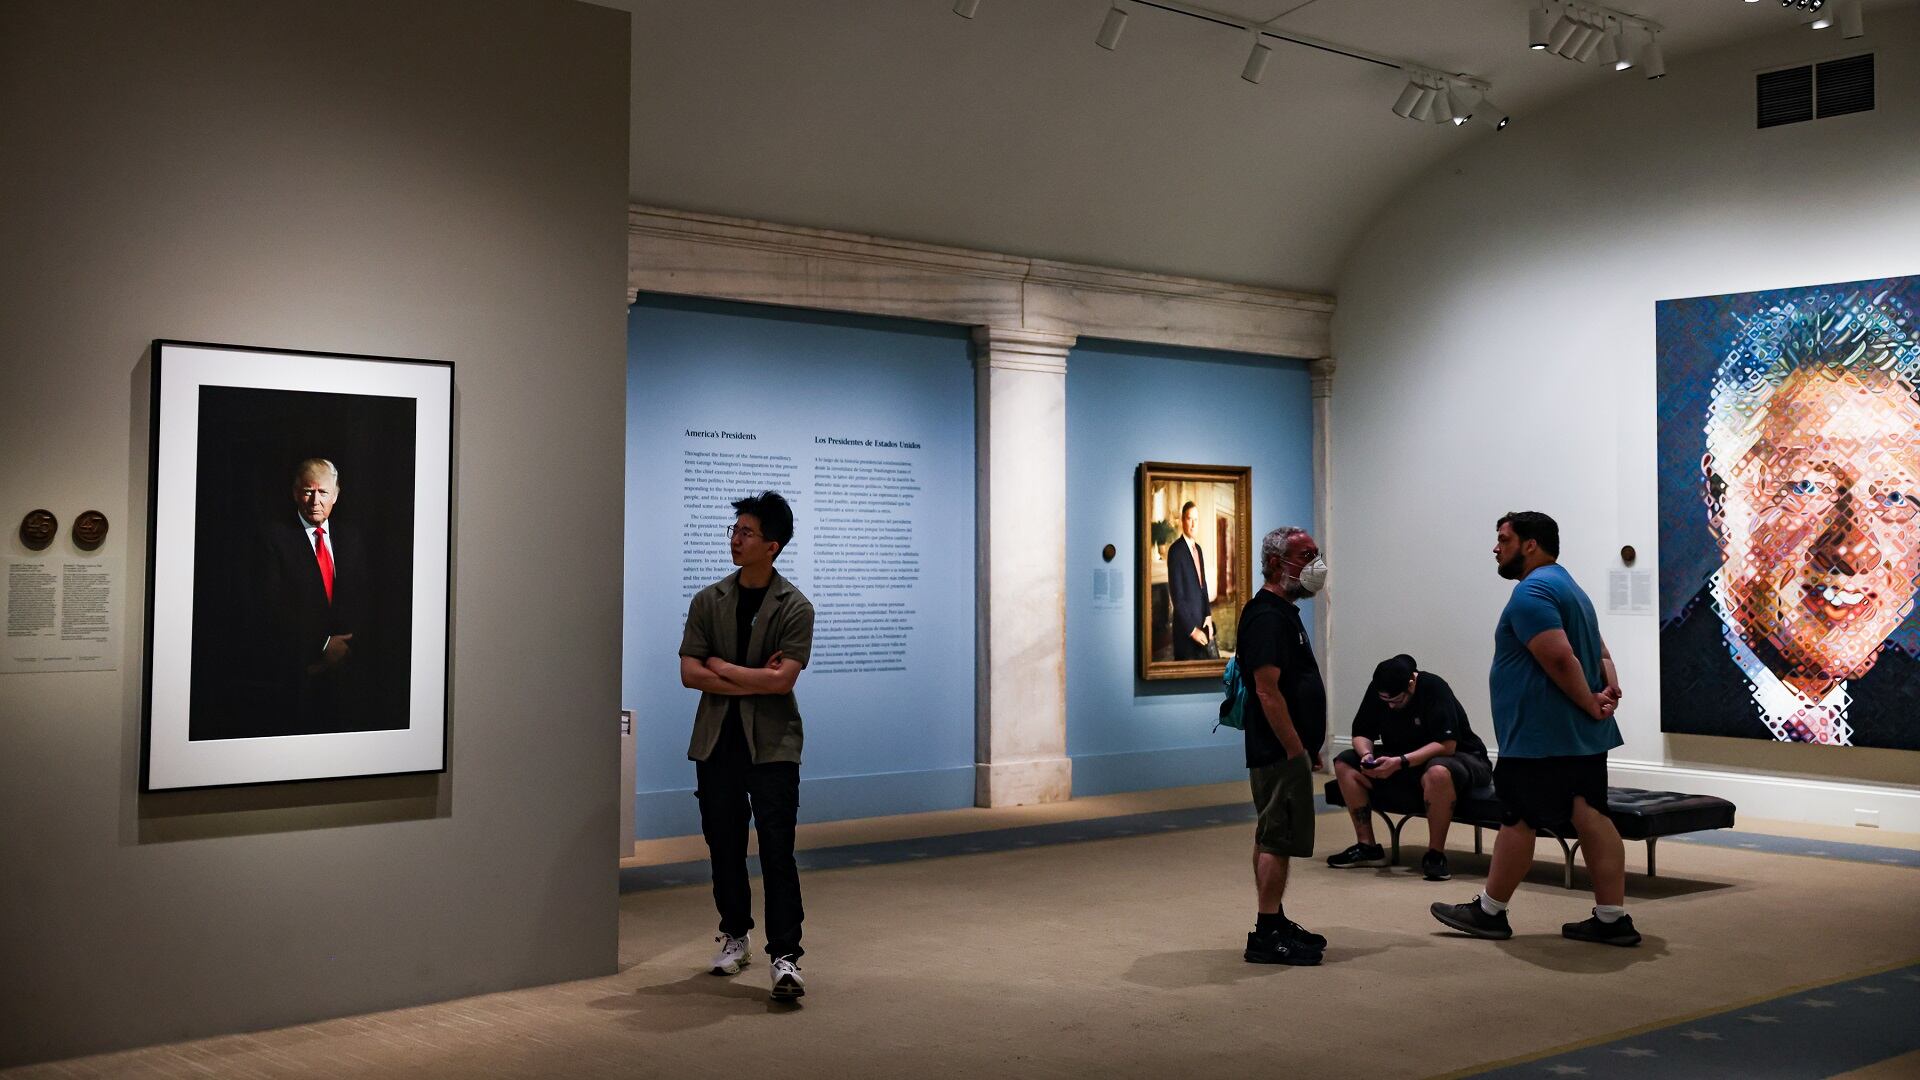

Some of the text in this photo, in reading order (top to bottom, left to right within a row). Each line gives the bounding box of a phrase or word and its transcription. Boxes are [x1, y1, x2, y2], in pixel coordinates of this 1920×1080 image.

[685, 429, 757, 440] America's Presidents
[815, 436, 826, 444] Los
[828, 437, 864, 446] Presidentes
[875, 440, 898, 448] Estados
[900, 441, 921, 449] Unidos
